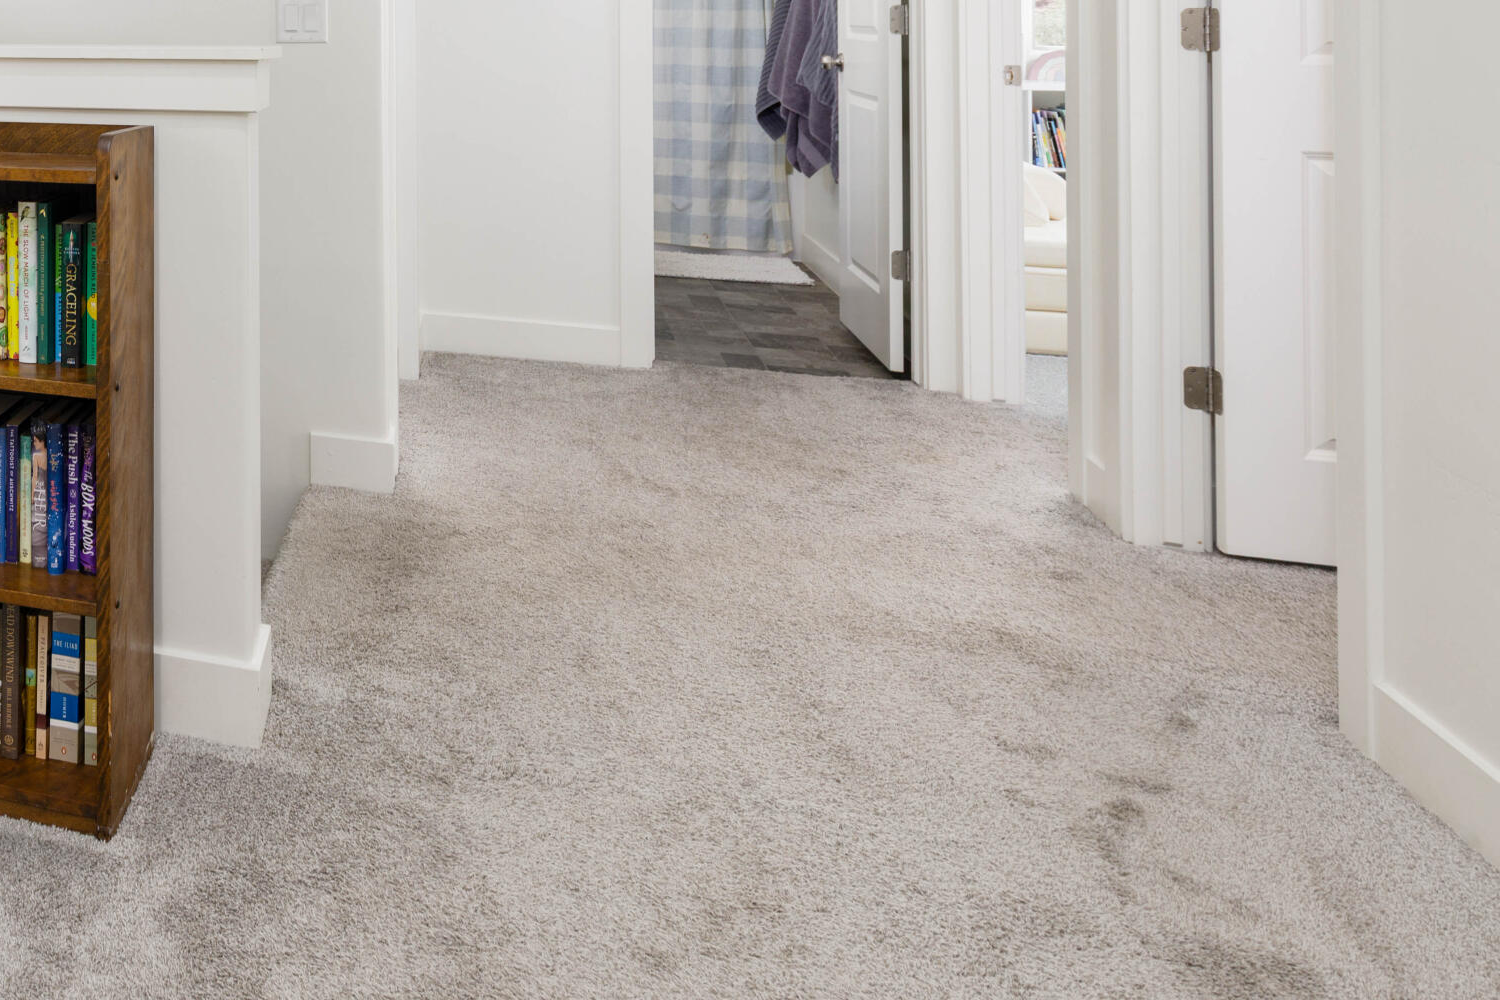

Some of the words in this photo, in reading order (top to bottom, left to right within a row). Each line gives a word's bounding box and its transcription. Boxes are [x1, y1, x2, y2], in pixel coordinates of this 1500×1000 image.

[24, 289, 29, 298] OF
[65, 264, 77, 346] GRACELING
[68, 431, 78, 454] The
[68, 455, 78, 484] Push
[81, 483, 95, 511] BOX
[82, 520, 95, 556] WOODS
[5, 627, 14, 683] DOWNWIND
